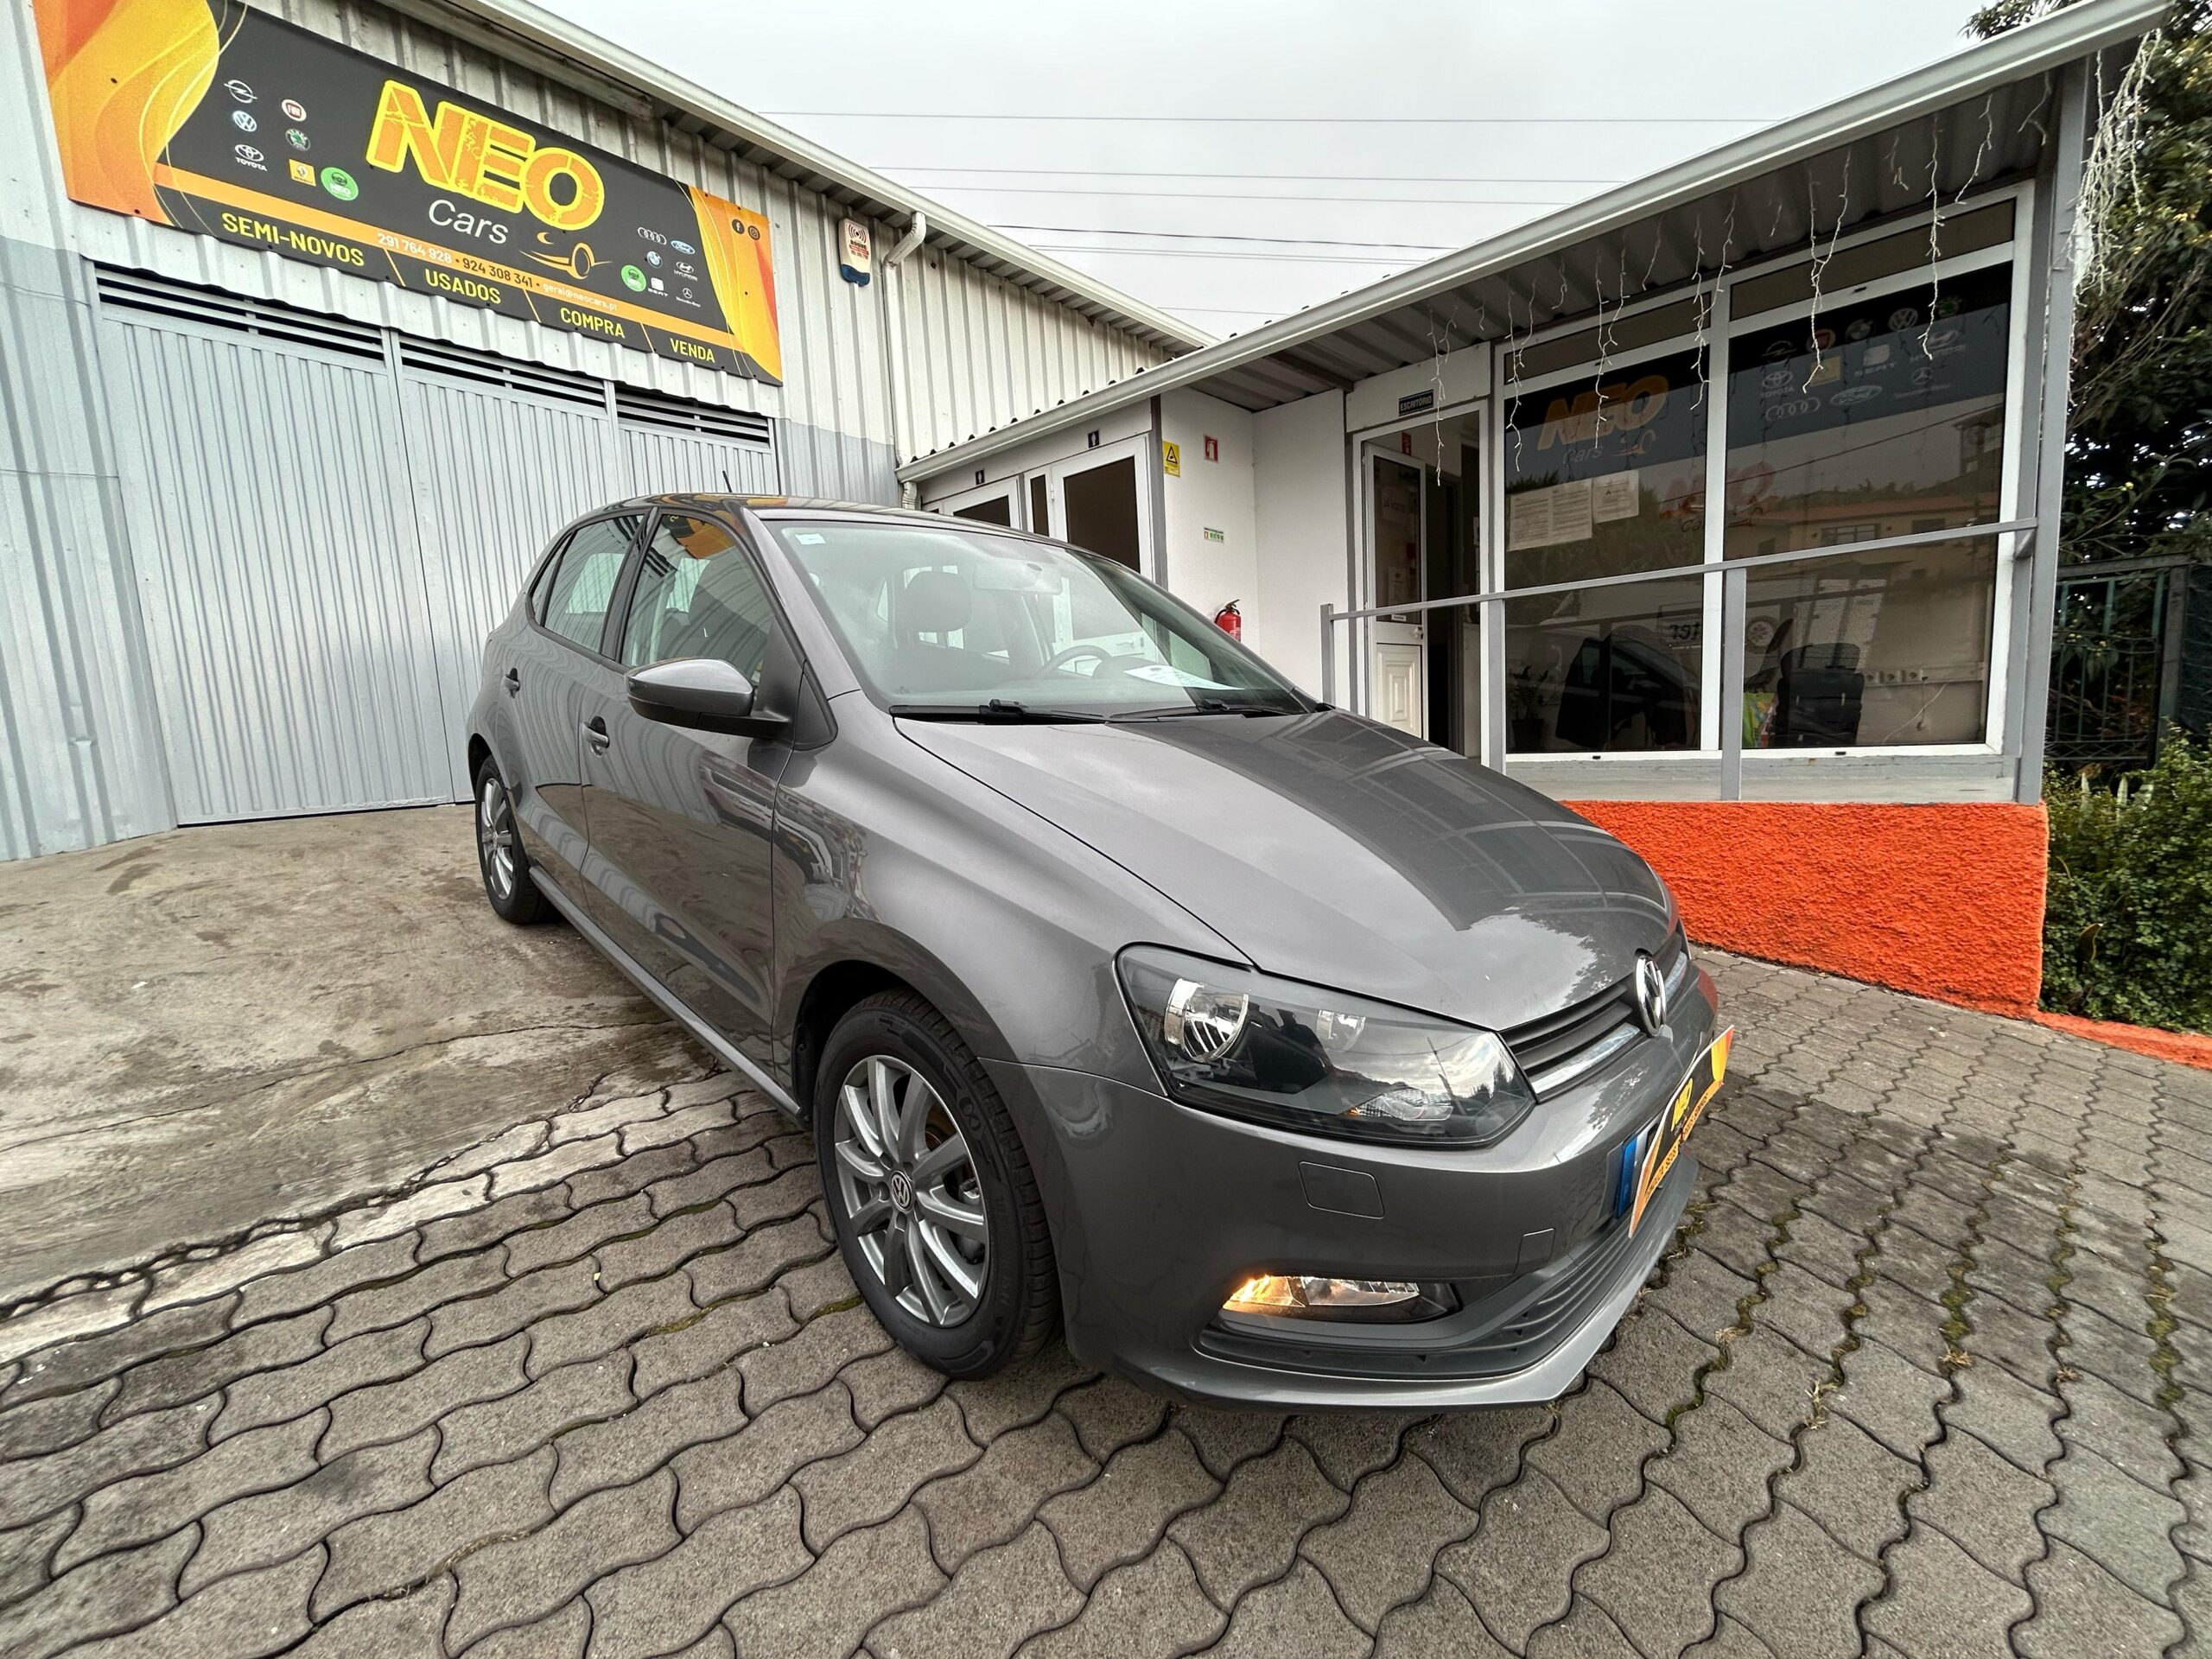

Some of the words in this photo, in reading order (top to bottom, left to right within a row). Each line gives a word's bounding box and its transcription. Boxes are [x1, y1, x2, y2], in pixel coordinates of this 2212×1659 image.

[235, 156, 268, 172] TOYOTA
[365, 79, 605, 232] NEO
[221, 213, 365, 266] SEMI-NOVOS
[429, 199, 508, 245] Cars
[378, 232, 399, 250] 291
[404, 239, 425, 257] 764
[429, 246, 452, 264] 928
[462, 257, 486, 274] 924
[488, 265, 511, 282] 308
[514, 270, 533, 288] 341
[543, 283, 618, 312] geral@neocars.pt
[423, 268, 501, 304] USADOS
[560, 307, 626, 339] COMPRA
[670, 337, 716, 364] VENDA
[1537, 374, 1670, 451] NEO
[1562, 448, 1603, 467] Cars
